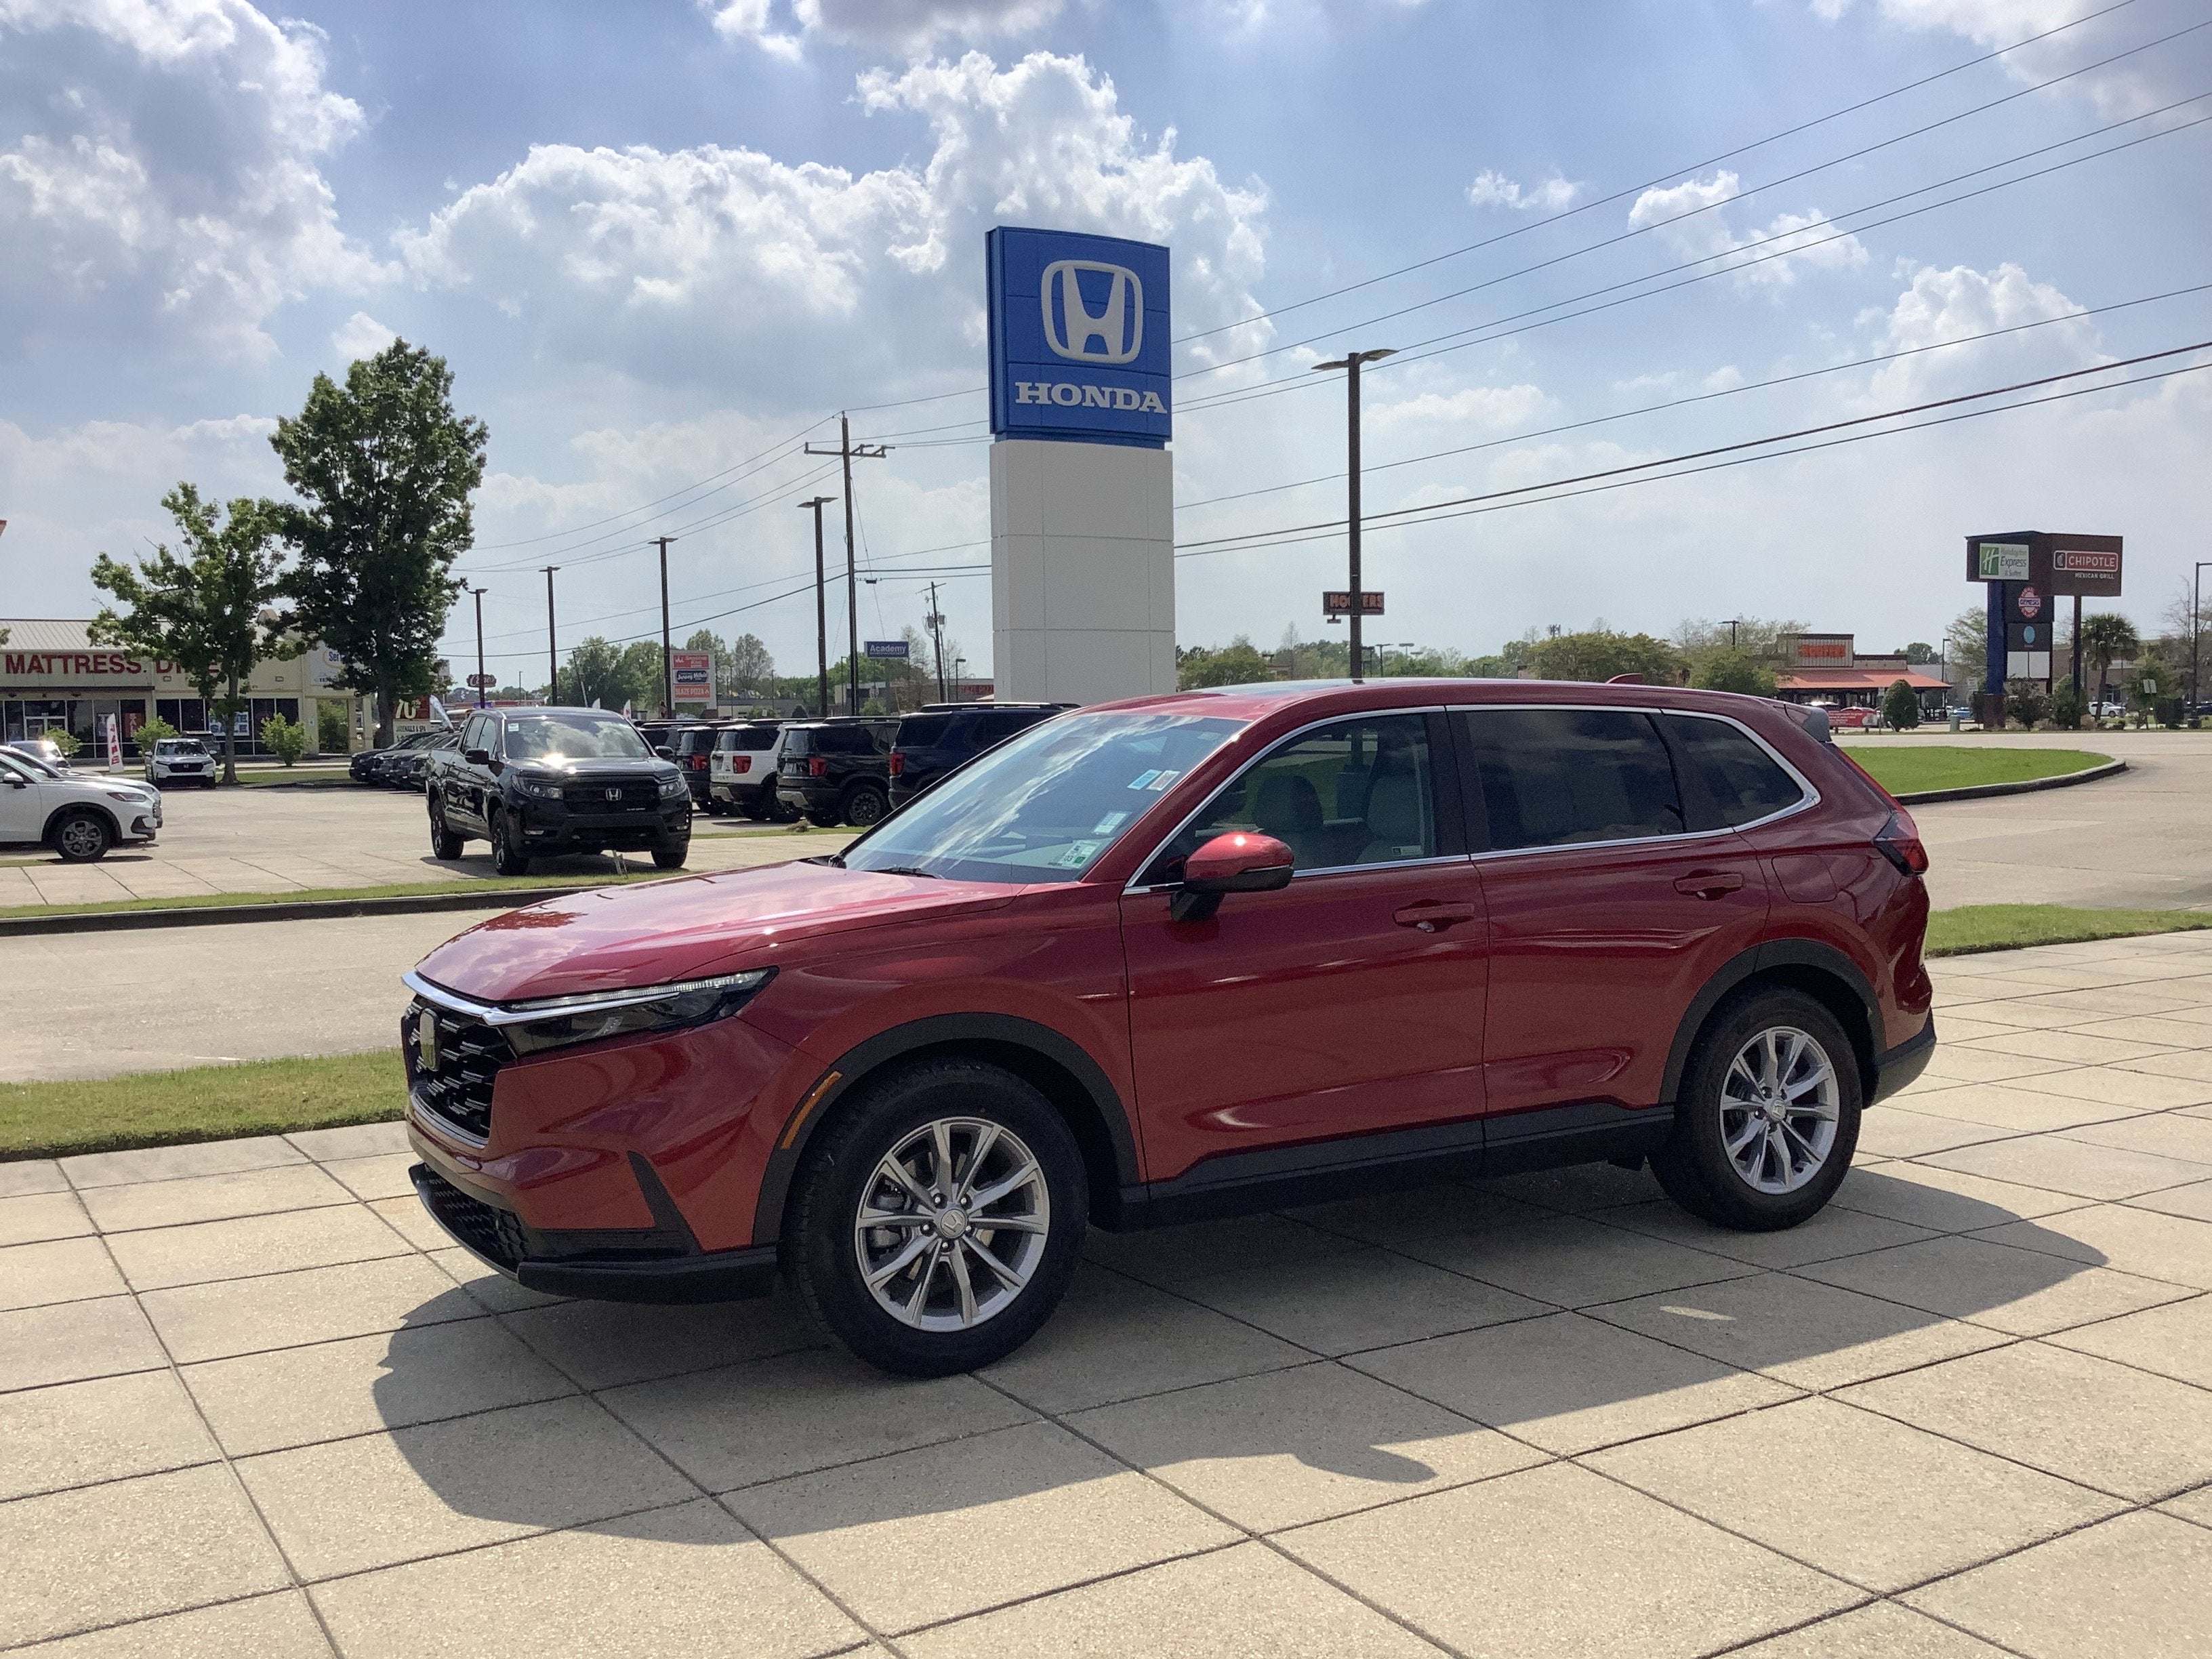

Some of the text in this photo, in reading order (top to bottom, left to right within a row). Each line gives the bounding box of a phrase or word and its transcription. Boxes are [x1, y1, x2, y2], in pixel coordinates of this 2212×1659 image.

[1015, 382, 1168, 414] HONDA
[2001, 556, 2028, 569] Express
[2068, 556, 2116, 567] CHIPOTLE
[1329, 594, 1384, 609] HOERS
[869, 644, 907, 654] Academy
[5, 654, 142, 674] MATTRESS
